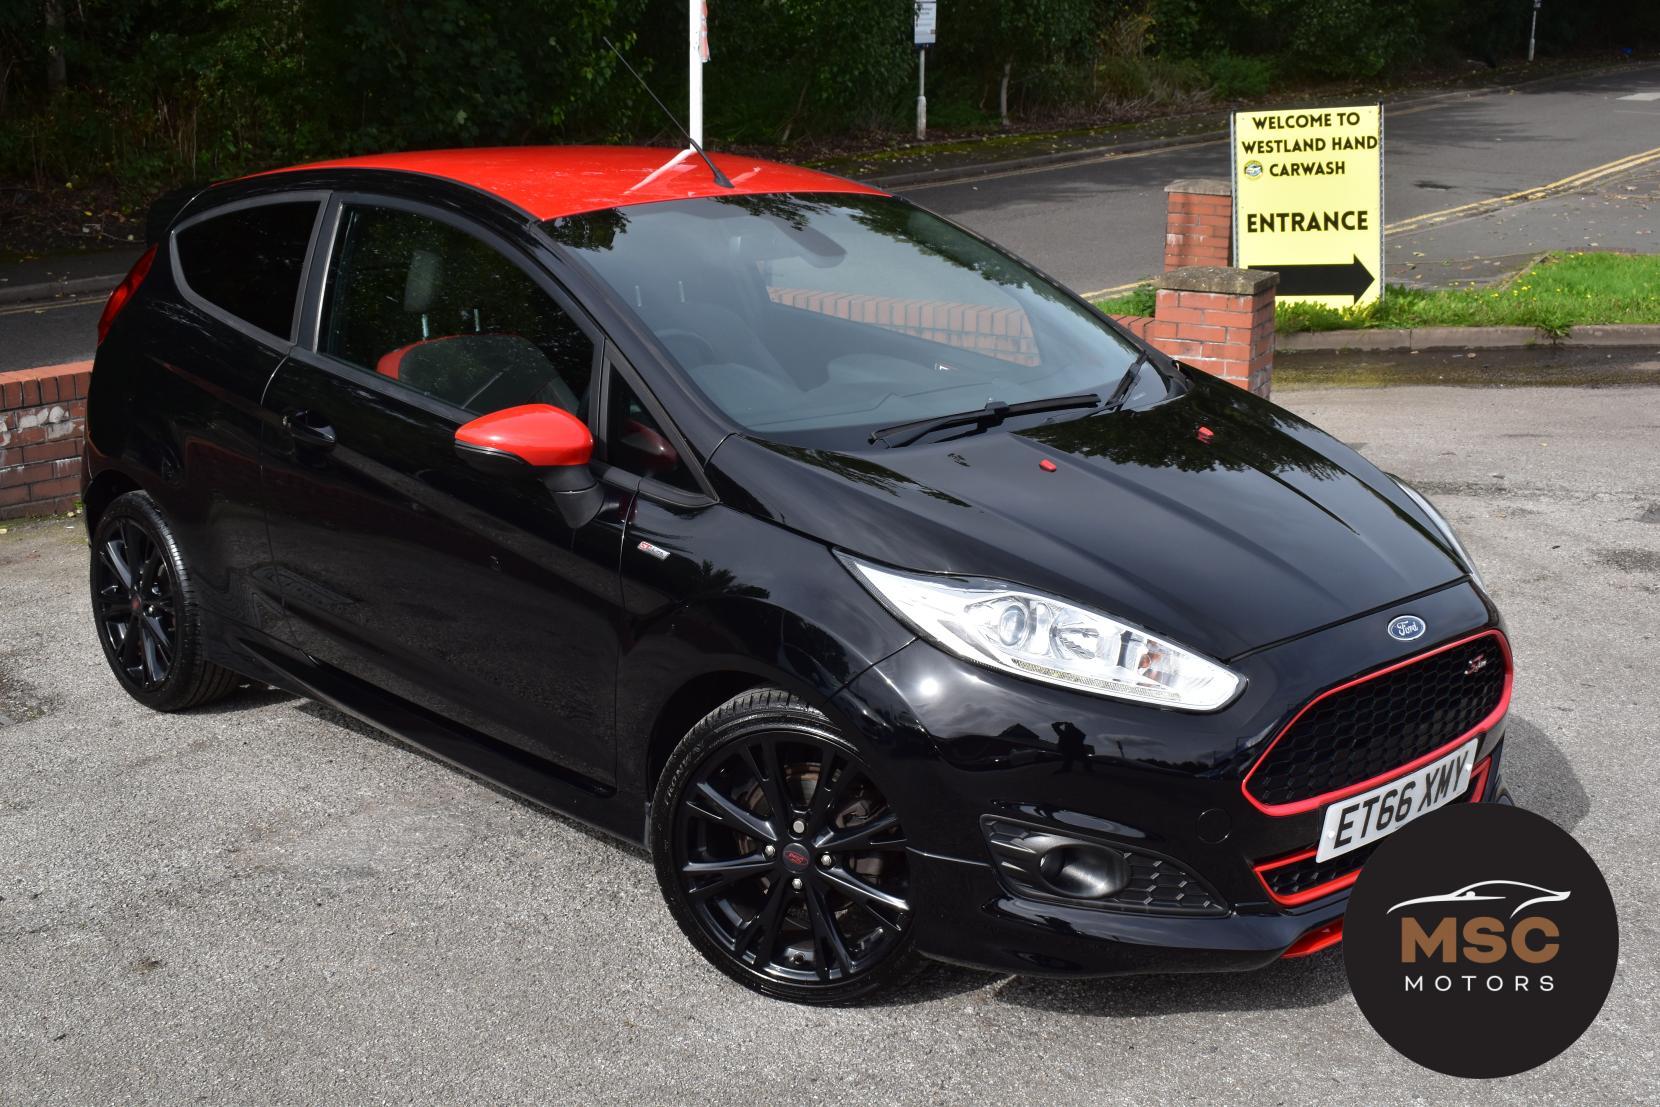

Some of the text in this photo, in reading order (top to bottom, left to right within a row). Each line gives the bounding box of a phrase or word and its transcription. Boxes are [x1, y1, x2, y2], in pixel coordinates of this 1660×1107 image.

[1252, 112, 1360, 130] WELCOME TO
[1242, 136, 1378, 154] WESTLAND HAND
[1269, 161, 1345, 177] CARWASH
[1247, 210, 1369, 233] ENTRANCE
[1396, 620, 1419, 636] Ford
[1333, 750, 1469, 850] ET66 XMY
